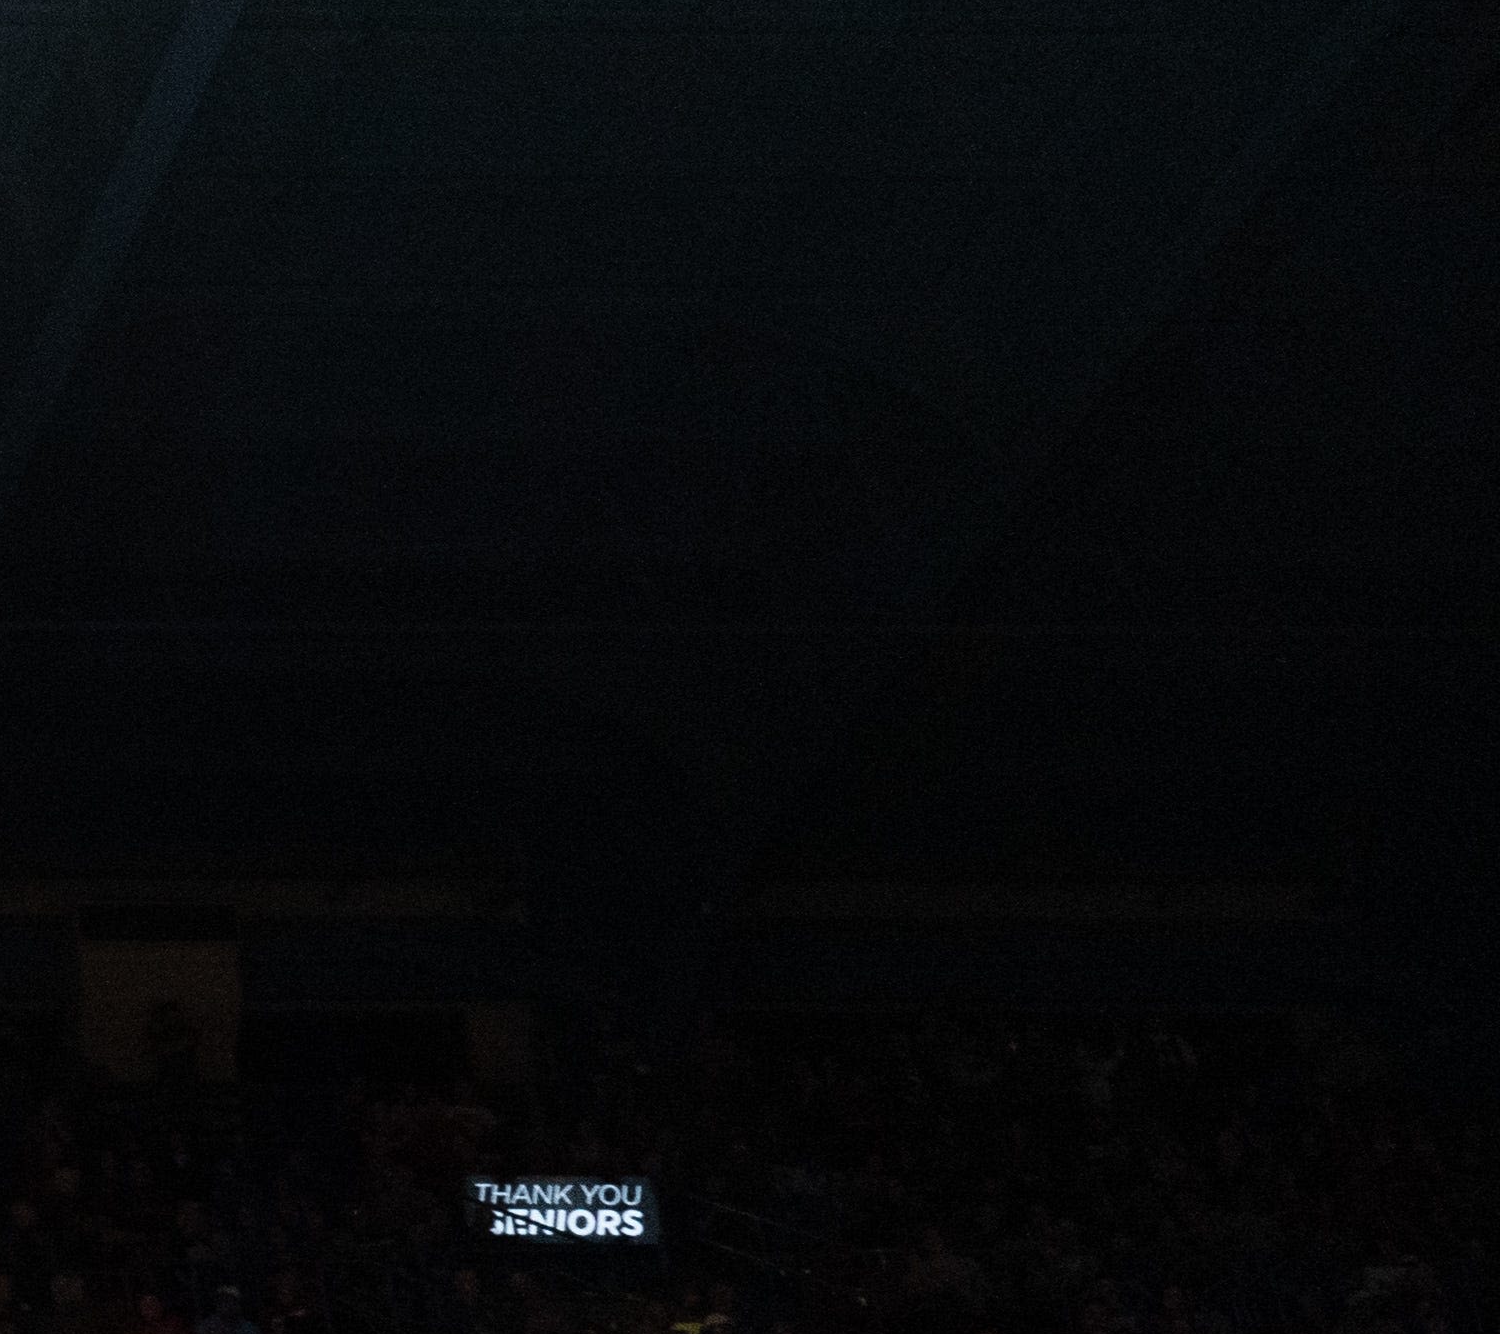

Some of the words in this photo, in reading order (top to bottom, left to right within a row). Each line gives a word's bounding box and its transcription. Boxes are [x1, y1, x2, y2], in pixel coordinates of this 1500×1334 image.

[474, 1182, 575, 1205] THANK
[579, 1183, 643, 1206] YOU
[490, 1208, 645, 1237] SENIORS
